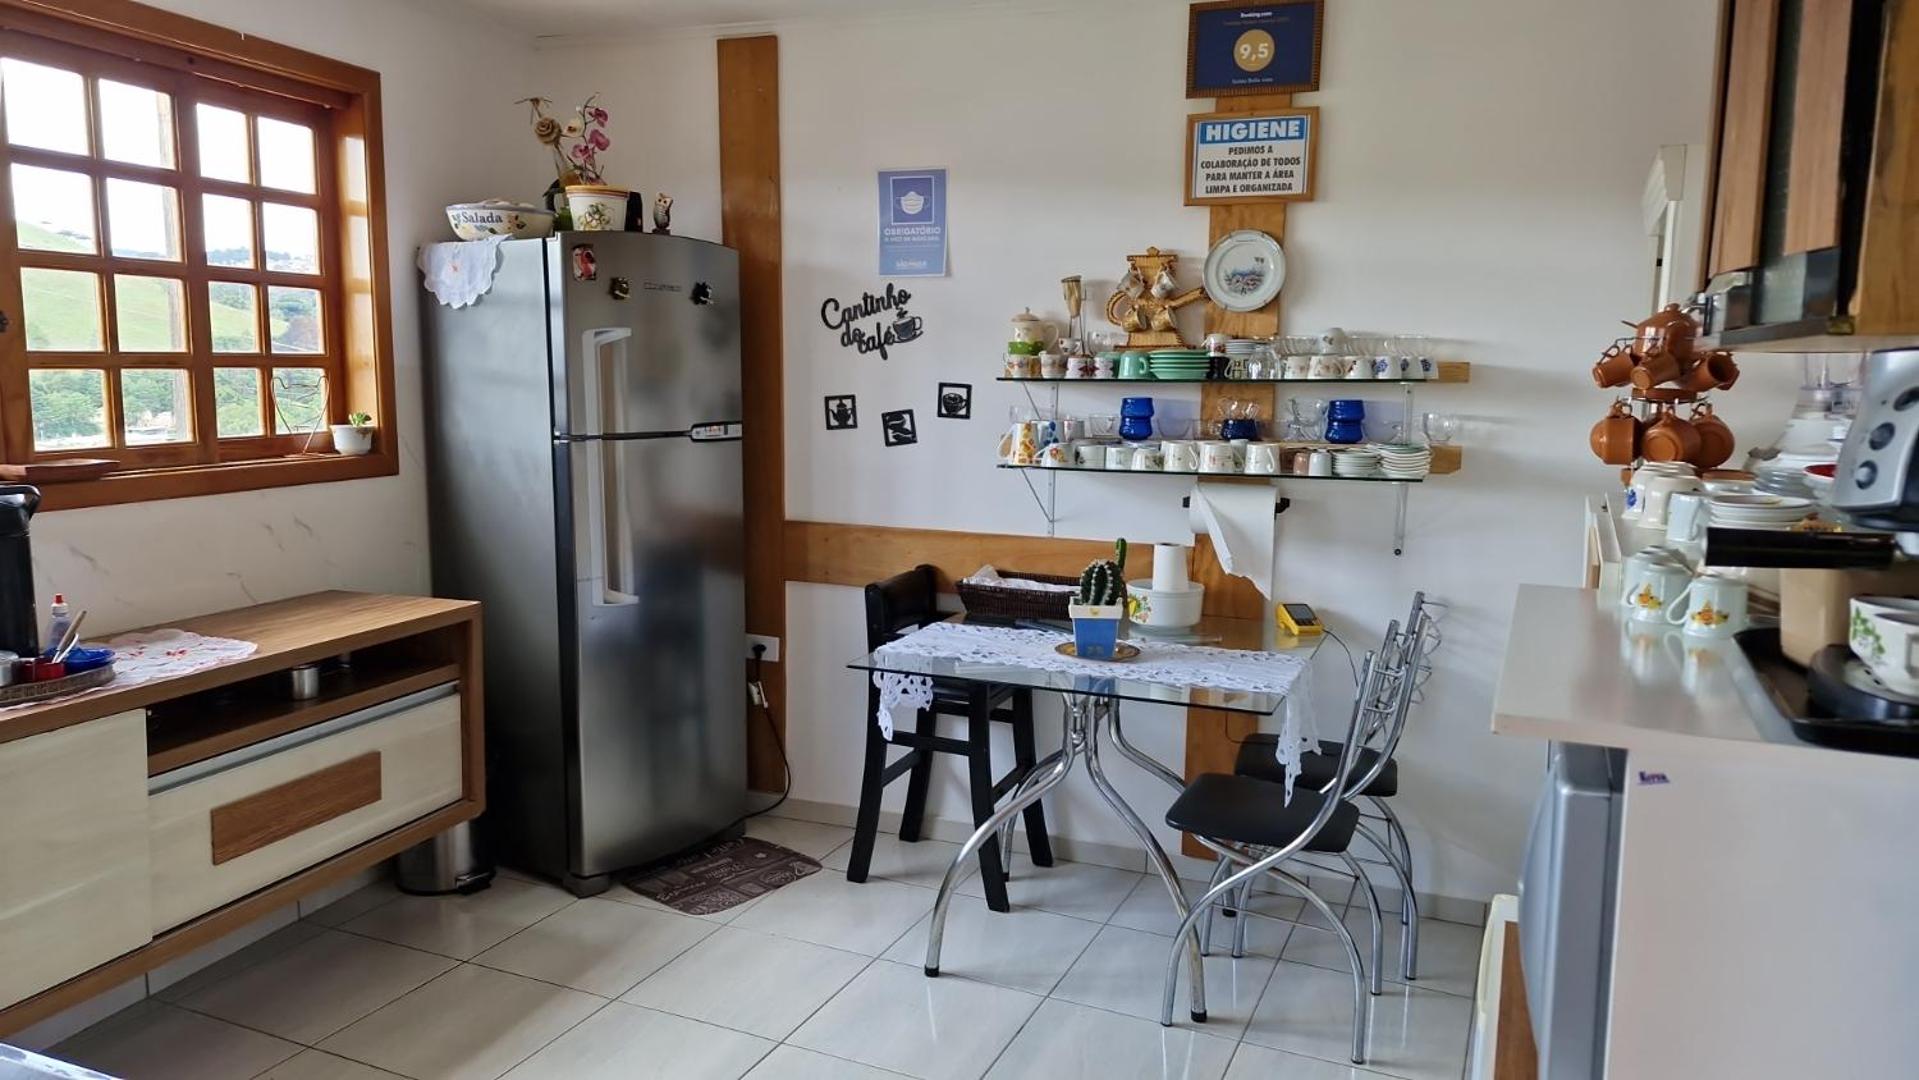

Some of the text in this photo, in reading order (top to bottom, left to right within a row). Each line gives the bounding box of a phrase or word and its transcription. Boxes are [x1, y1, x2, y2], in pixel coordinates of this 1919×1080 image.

[1239, 43, 1269, 61] 9,5
[1206, 120, 1301, 142] HIGIENE
[1228, 145, 1274, 155] PEDIMOS A
[1200, 157, 1301, 169] COLABORAÇÃO DE TODOS
[1205, 167, 1294, 181] PARA MANTER A ÁREA
[1205, 182, 1293, 194] LIMPA E ORGANIZADA
[461, 211, 503, 224] Salada
[821, 283, 911, 330] Cantinho
[841, 319, 895, 361] do café
